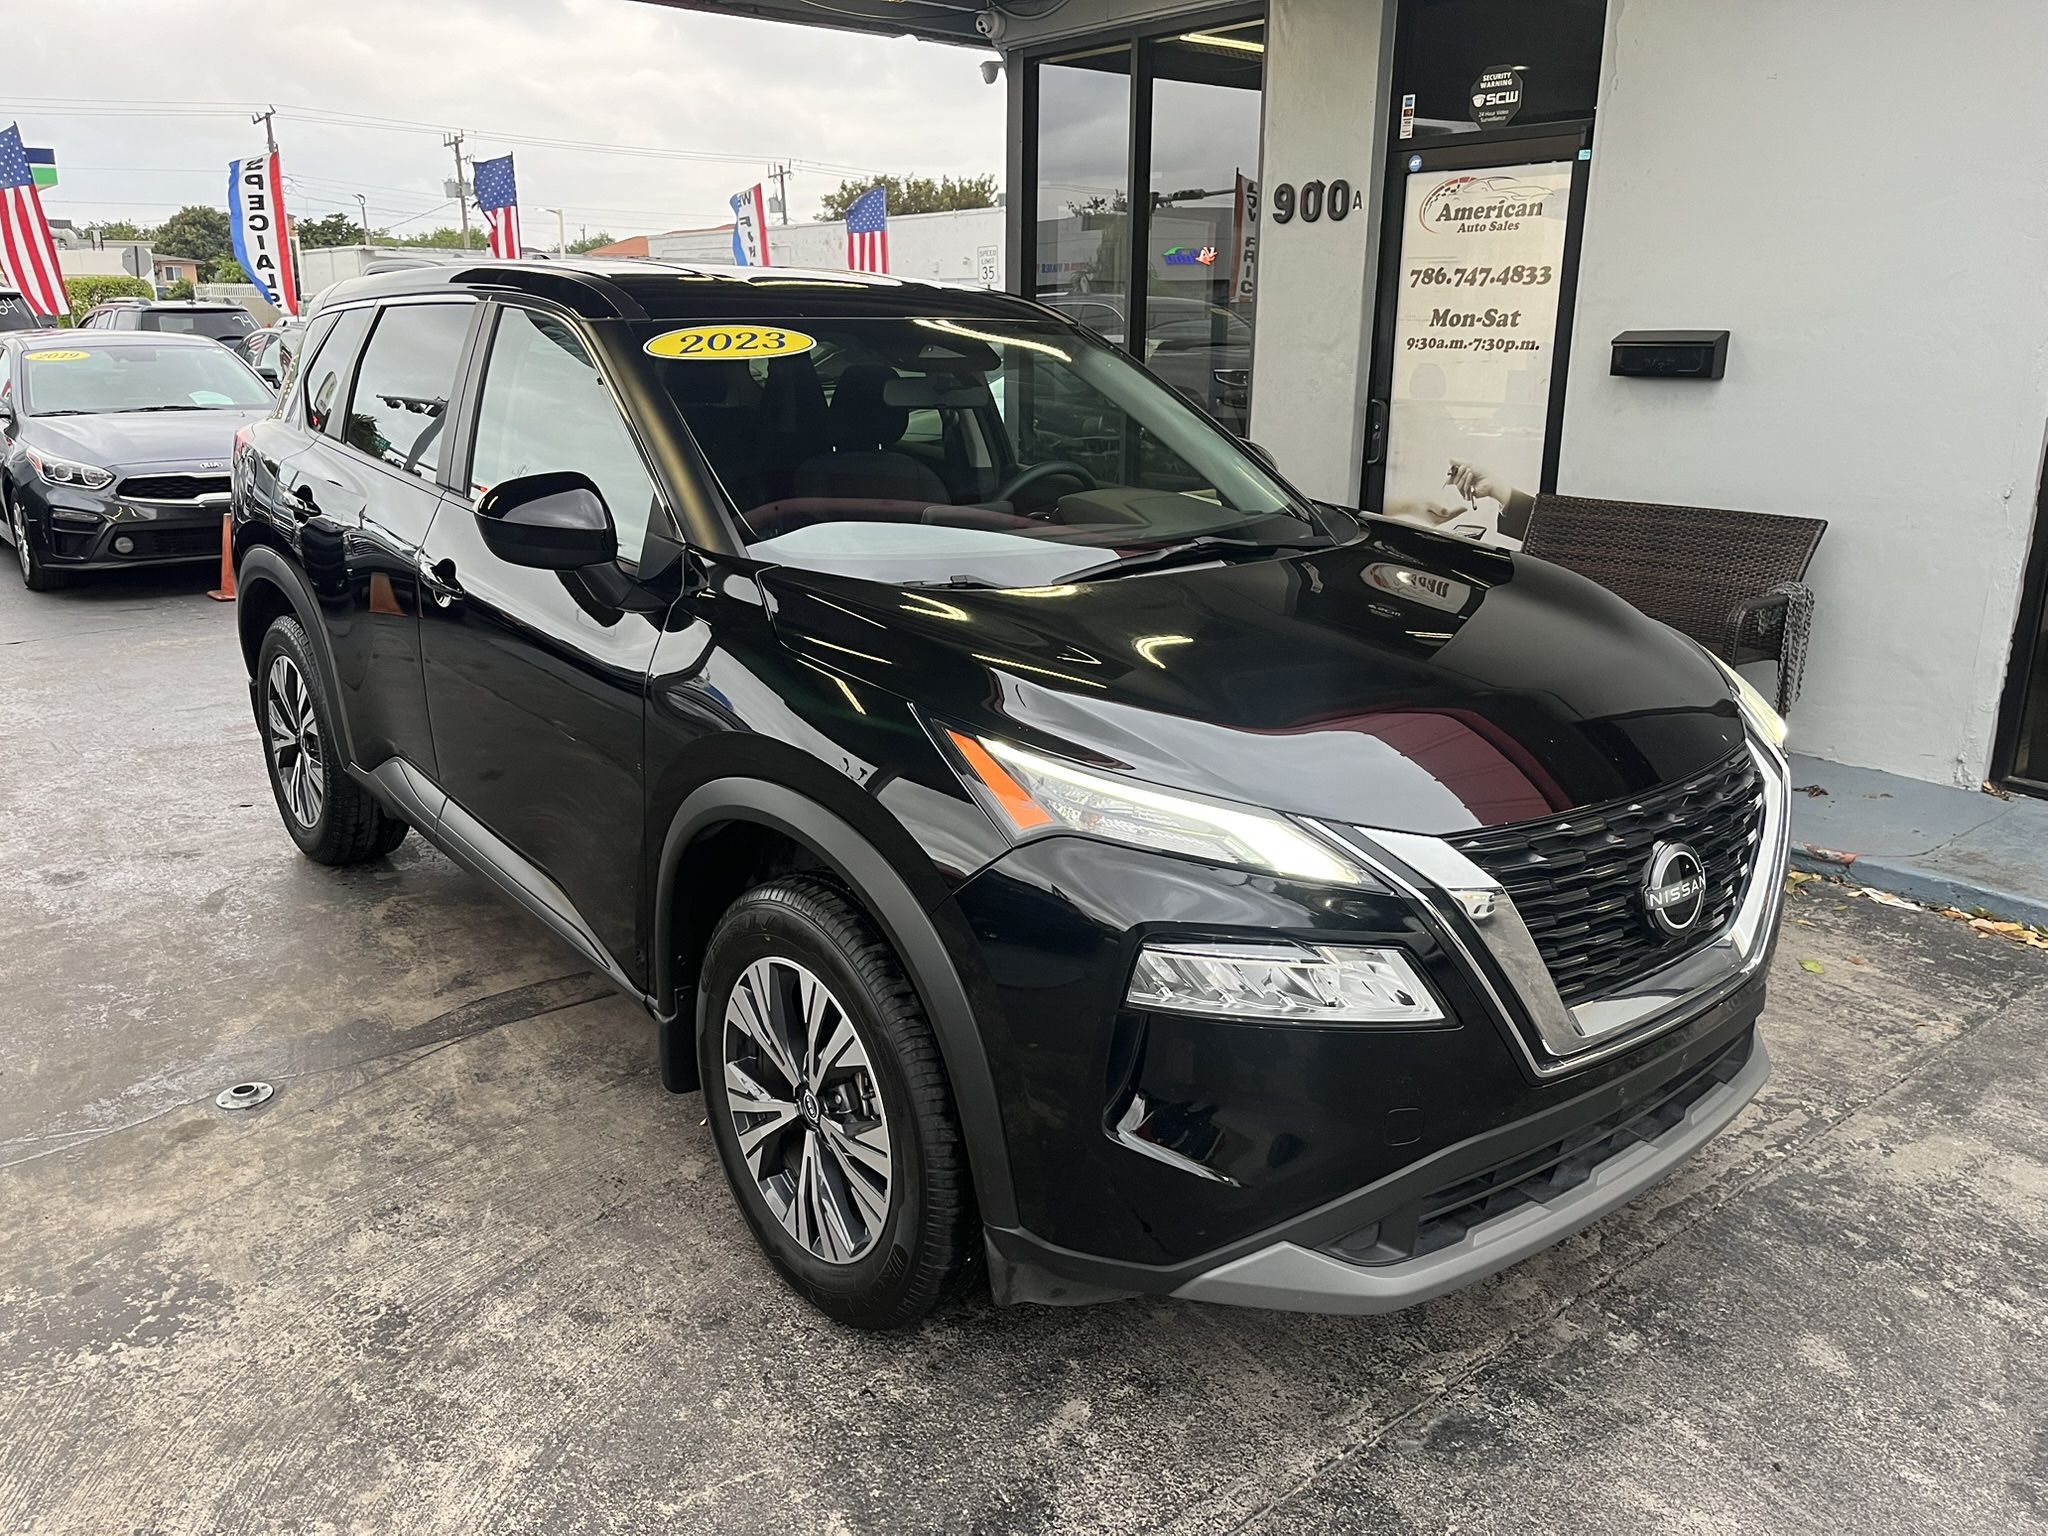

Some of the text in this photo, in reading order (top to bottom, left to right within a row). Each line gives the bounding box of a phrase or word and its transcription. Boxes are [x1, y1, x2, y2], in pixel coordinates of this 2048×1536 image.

[1480, 79, 1512, 89] WARNING
[1482, 72, 1511, 82] SECURITY
[1485, 90, 1519, 106] SCW
[1272, 179, 1362, 225] 900 A
[1435, 199, 1543, 222] American
[1457, 220, 1520, 233] Auto Sales
[982, 265, 995, 280] 35
[1409, 265, 1552, 288] 786.747.4833
[1428, 308, 1521, 328] Mon-Sat
[679, 332, 786, 355] 2023
[1406, 337, 1540, 353] 9:30a.m.-7:30p.m.
[36, 352, 80, 360] 2019
[1649, 875, 1705, 907] NISSAN
